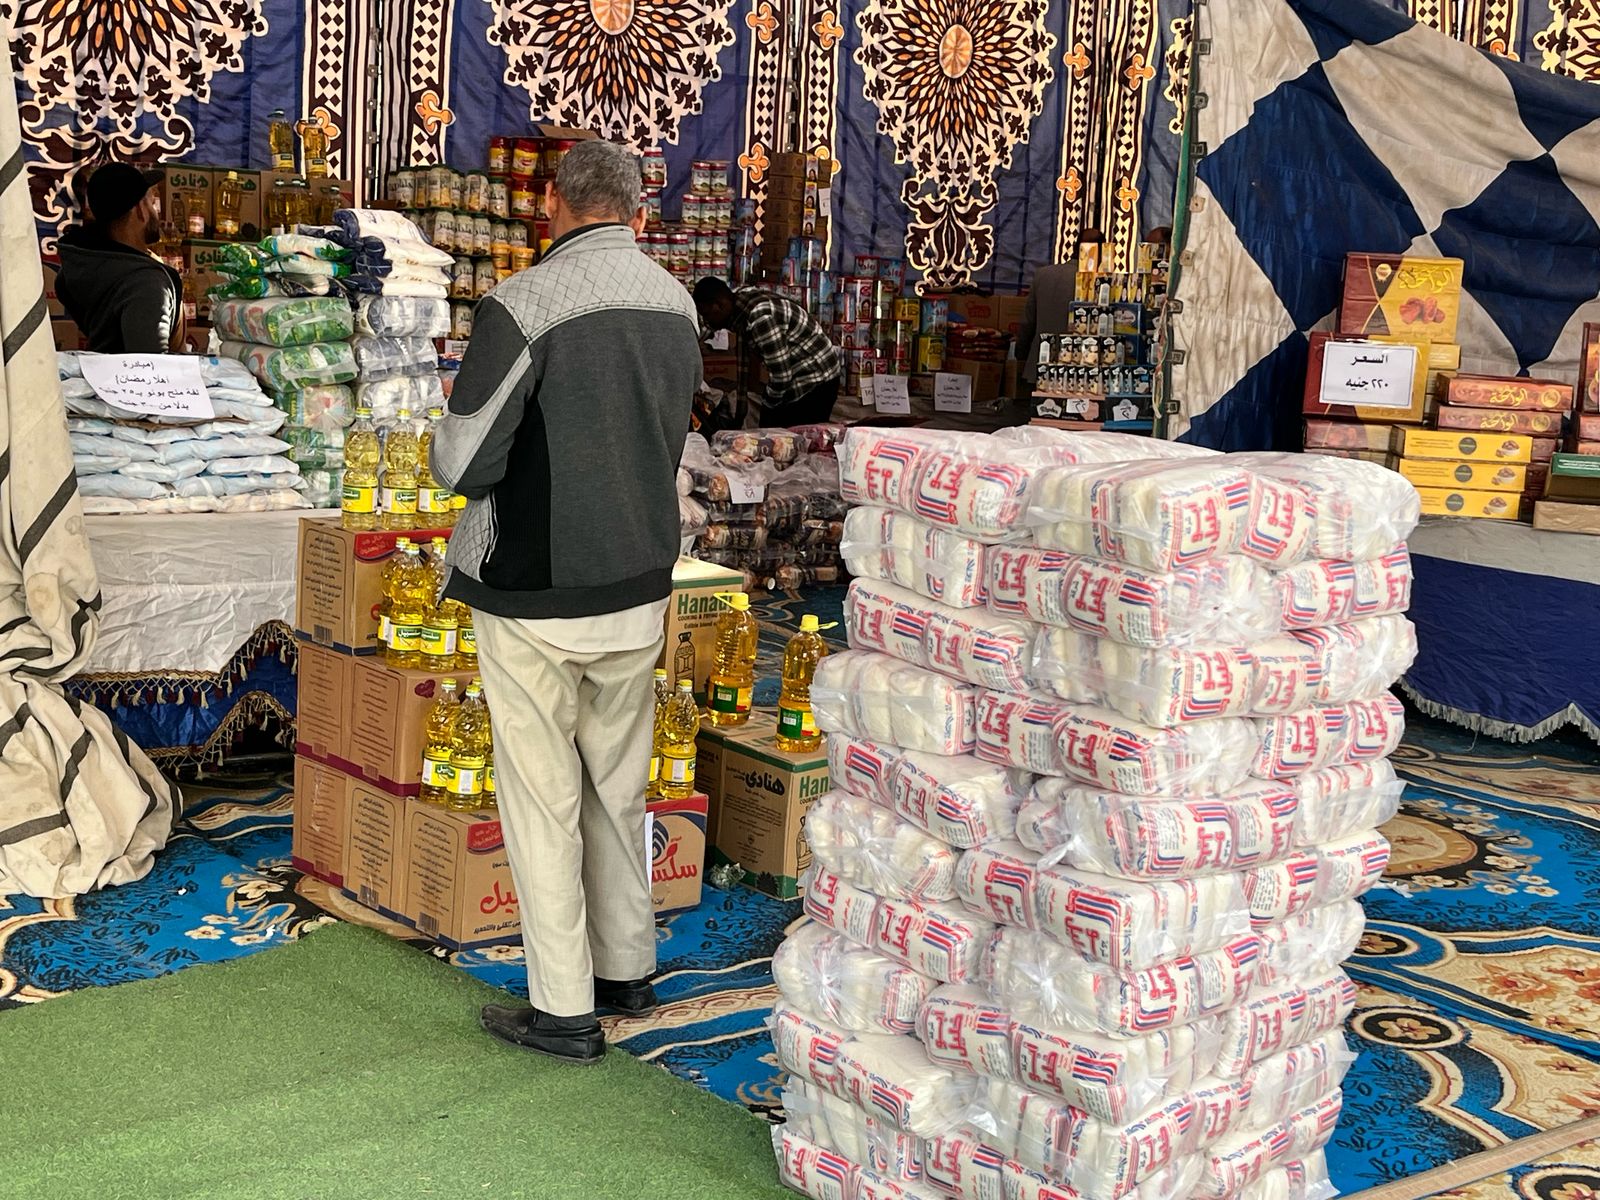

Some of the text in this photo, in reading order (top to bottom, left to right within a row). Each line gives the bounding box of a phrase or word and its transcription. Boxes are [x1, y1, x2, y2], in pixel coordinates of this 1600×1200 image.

[1351, 354, 1389, 366] السعر
[1345, 377, 1389, 391] ٢٢٠ جنيه
[1203, 497, 1221, 543] خليل
[1279, 493, 1296, 539] خليل
[1010, 553, 1030, 598] خليل
[1087, 576, 1110, 622] خليل
[992, 701, 1017, 744] خليل
[1302, 715, 1317, 758] خليل
[1078, 733, 1098, 778] خليل
[1196, 826, 1214, 869] خليل
[893, 913, 912, 958] خليل
[946, 1013, 968, 1057] خليل
[1041, 1051, 1063, 1095] خليل
